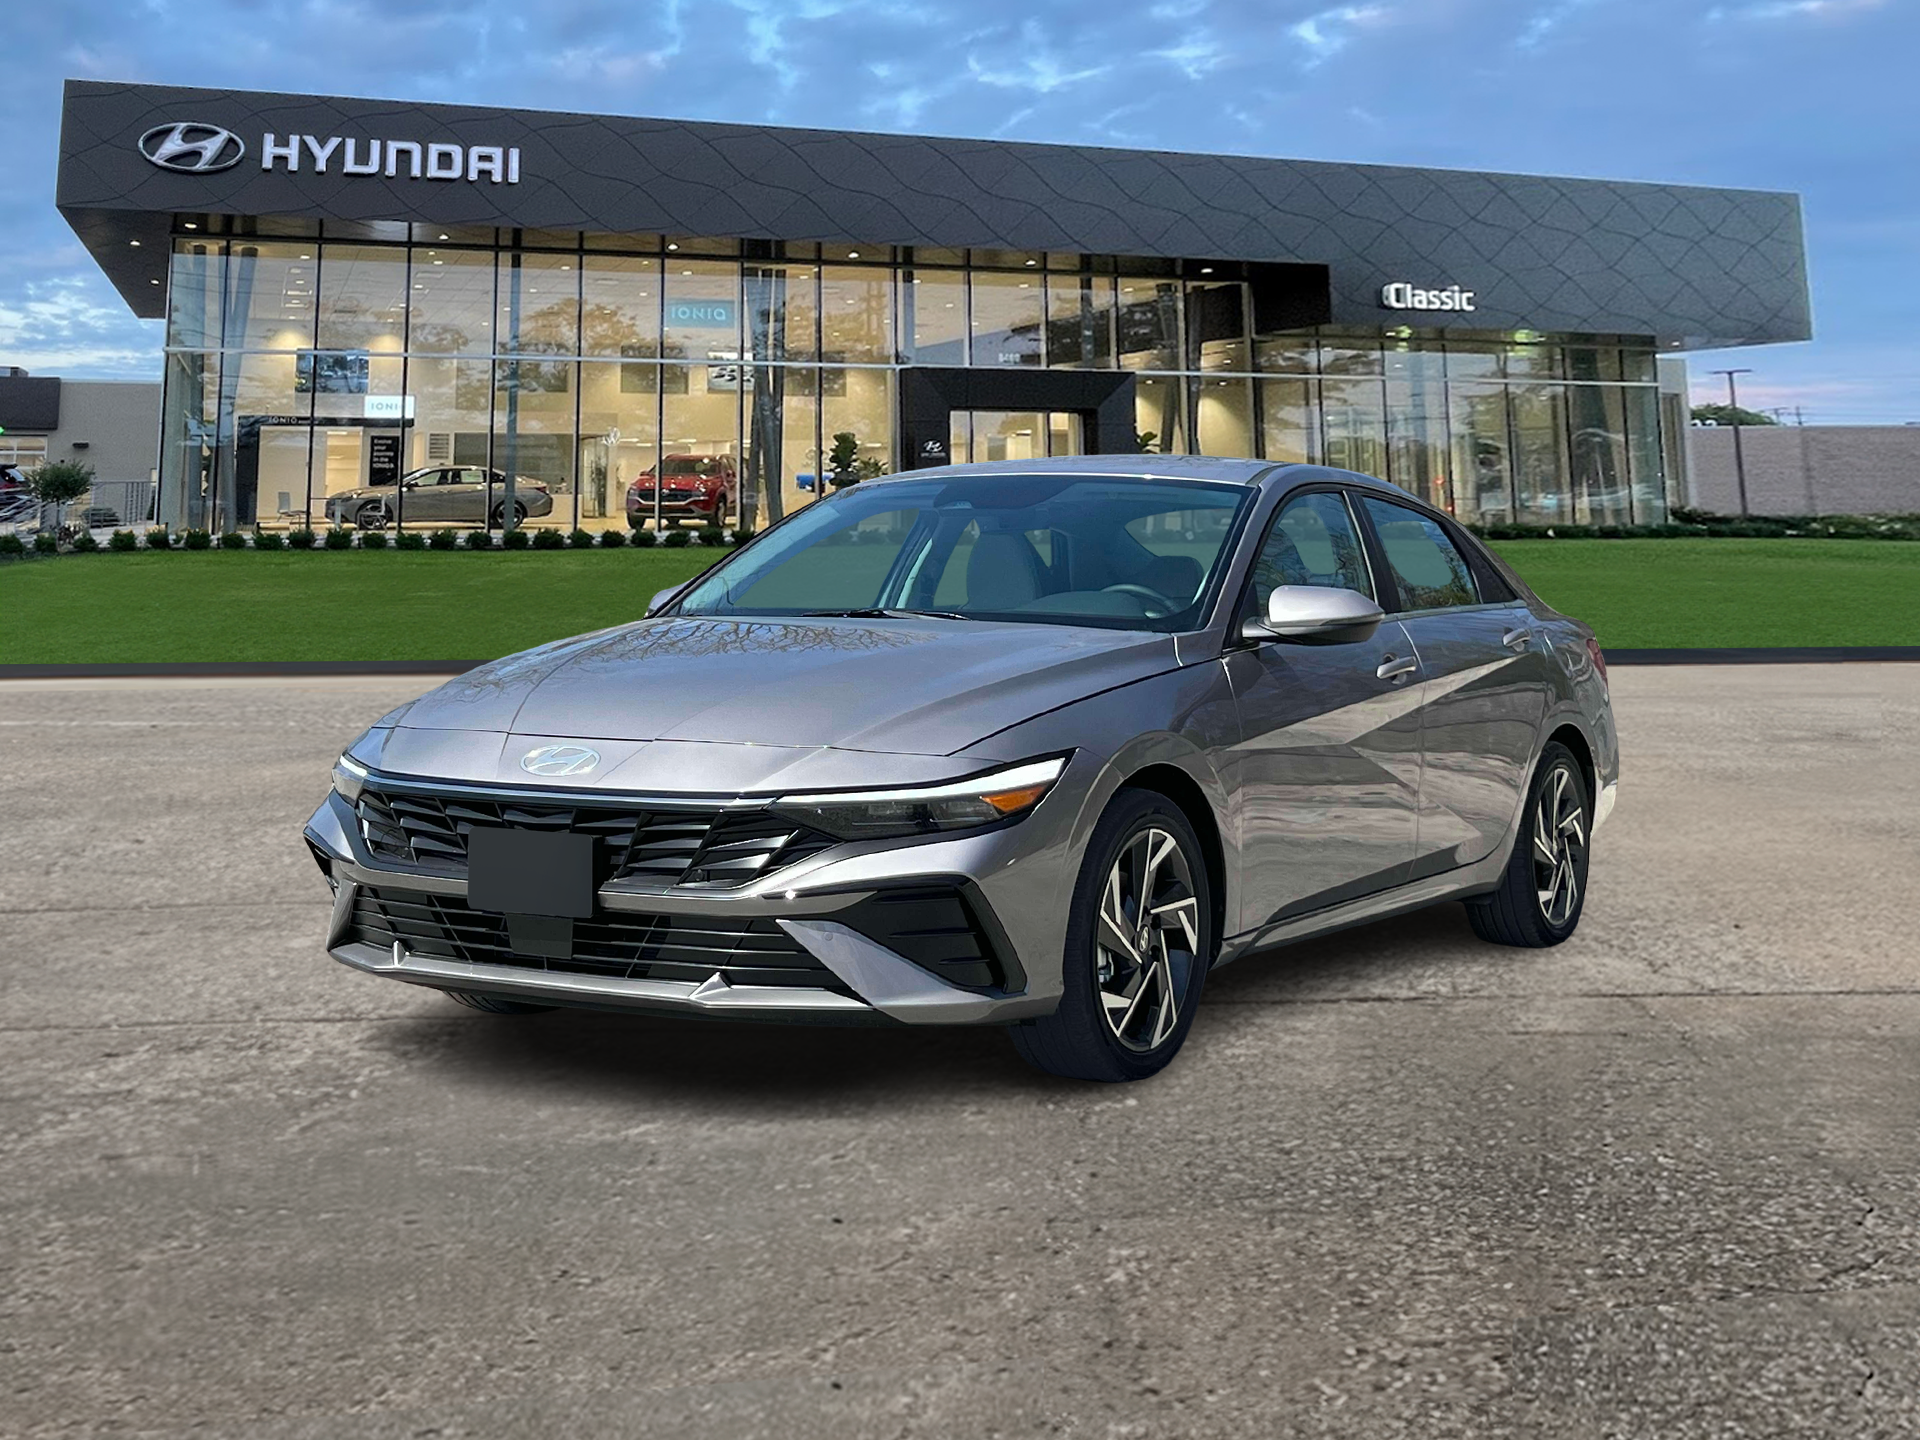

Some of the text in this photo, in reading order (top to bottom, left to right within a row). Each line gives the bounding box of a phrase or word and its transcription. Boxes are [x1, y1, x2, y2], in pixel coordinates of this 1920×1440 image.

[261, 132, 520, 184] HYUNDAI
[1382, 282, 1475, 312] Classic
[671, 306, 726, 321] IONIQ
[371, 402, 402, 411] IONI
